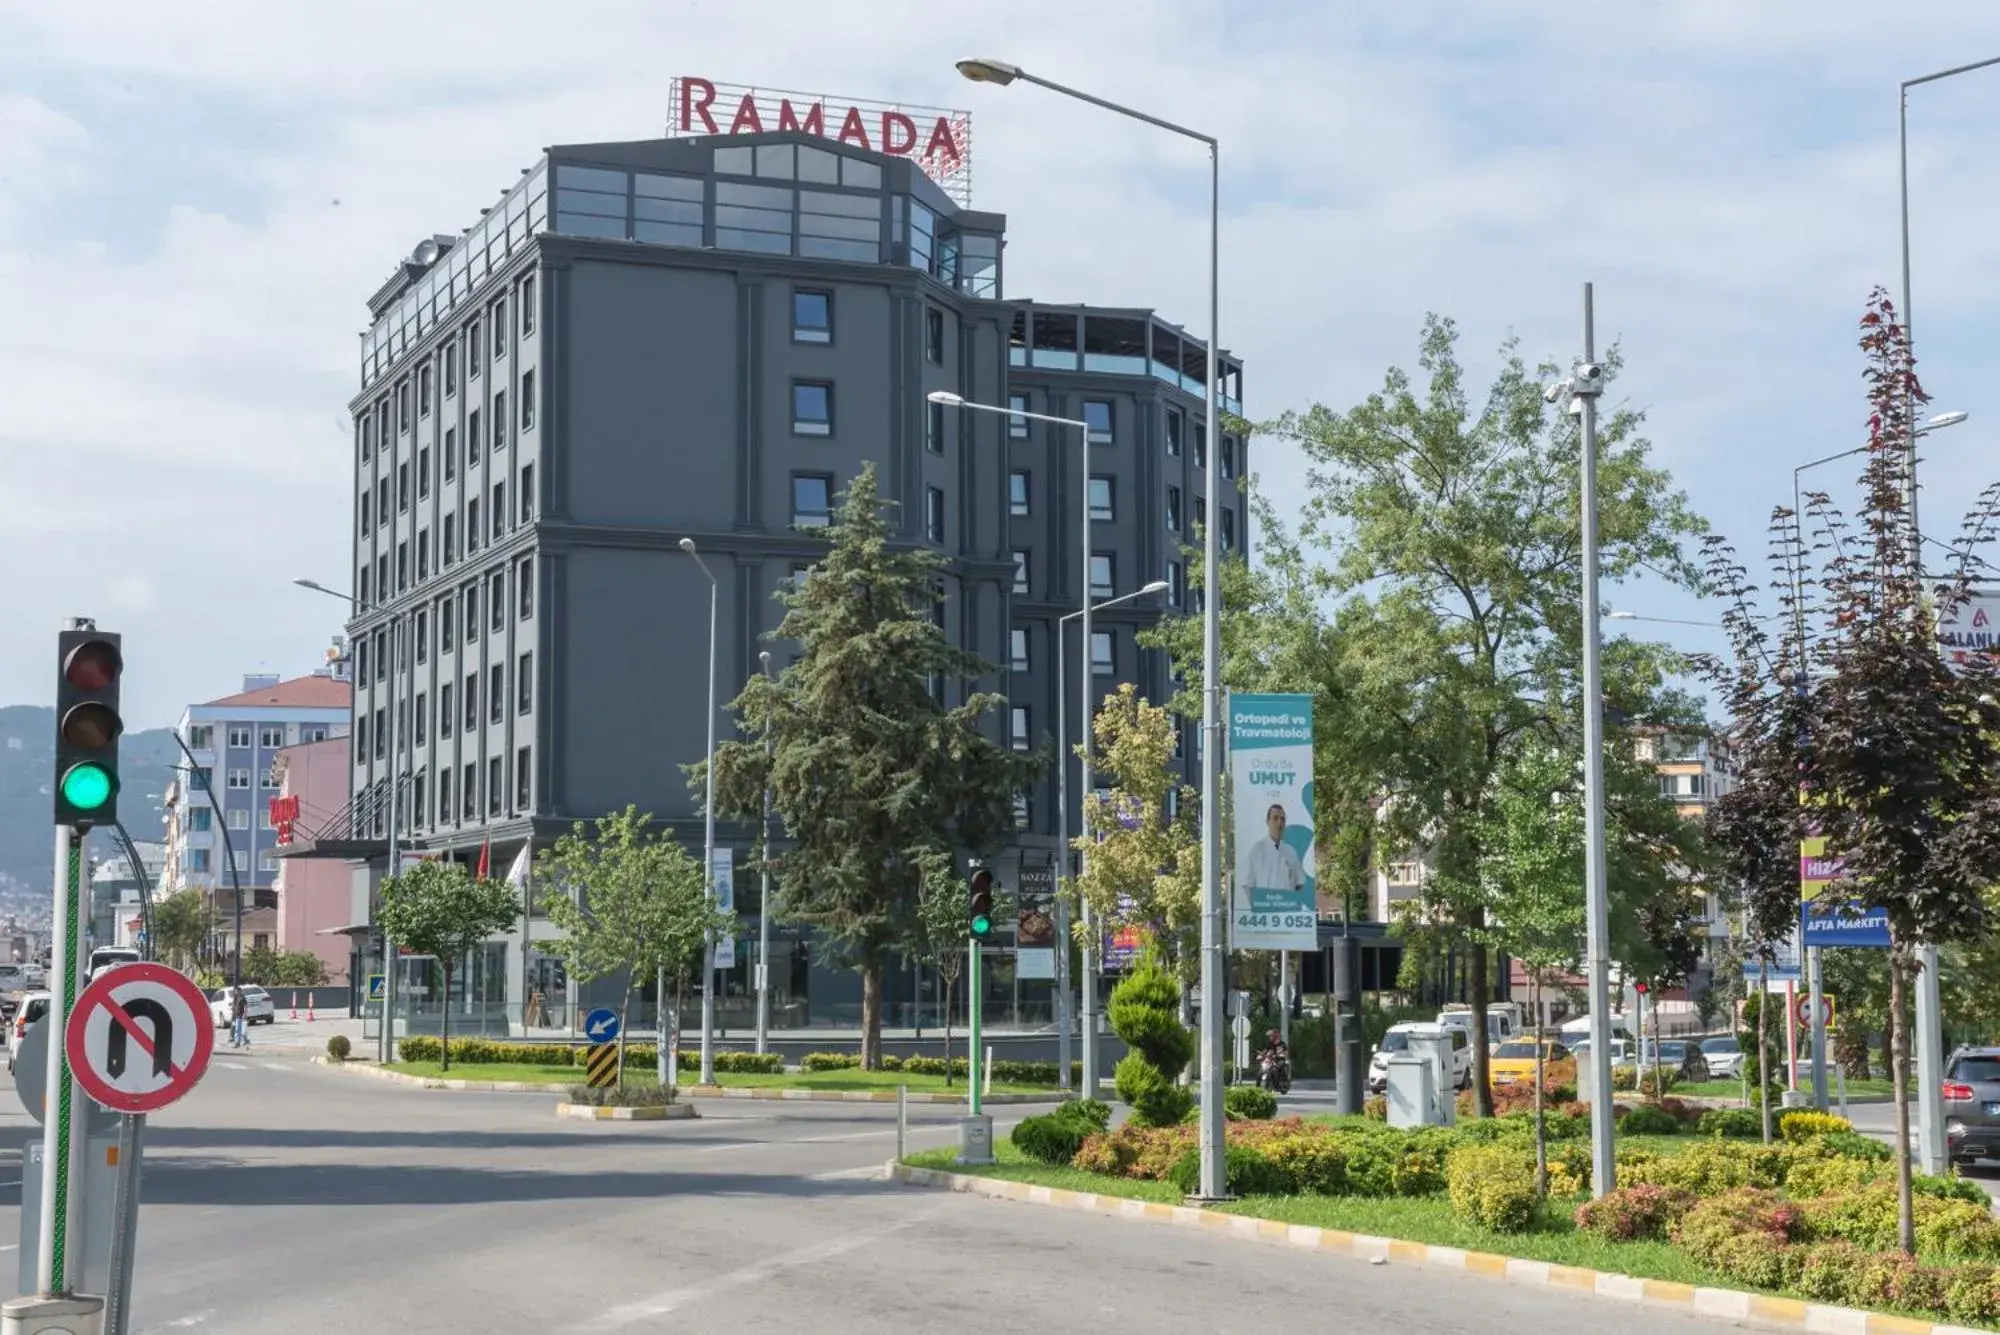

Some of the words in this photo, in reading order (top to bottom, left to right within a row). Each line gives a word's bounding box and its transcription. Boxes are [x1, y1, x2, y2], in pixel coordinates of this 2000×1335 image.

[681, 76, 961, 162] RAMADA
[1234, 713, 1289, 726] Ortopedi
[1292, 716, 1306, 725] ve
[1233, 726, 1311, 740] Travmatoloji
[1249, 771, 1296, 785] UMUT
[1238, 914, 1267, 928] 444
[1271, 915, 1281, 928] 9
[1285, 915, 1313, 928] 052
